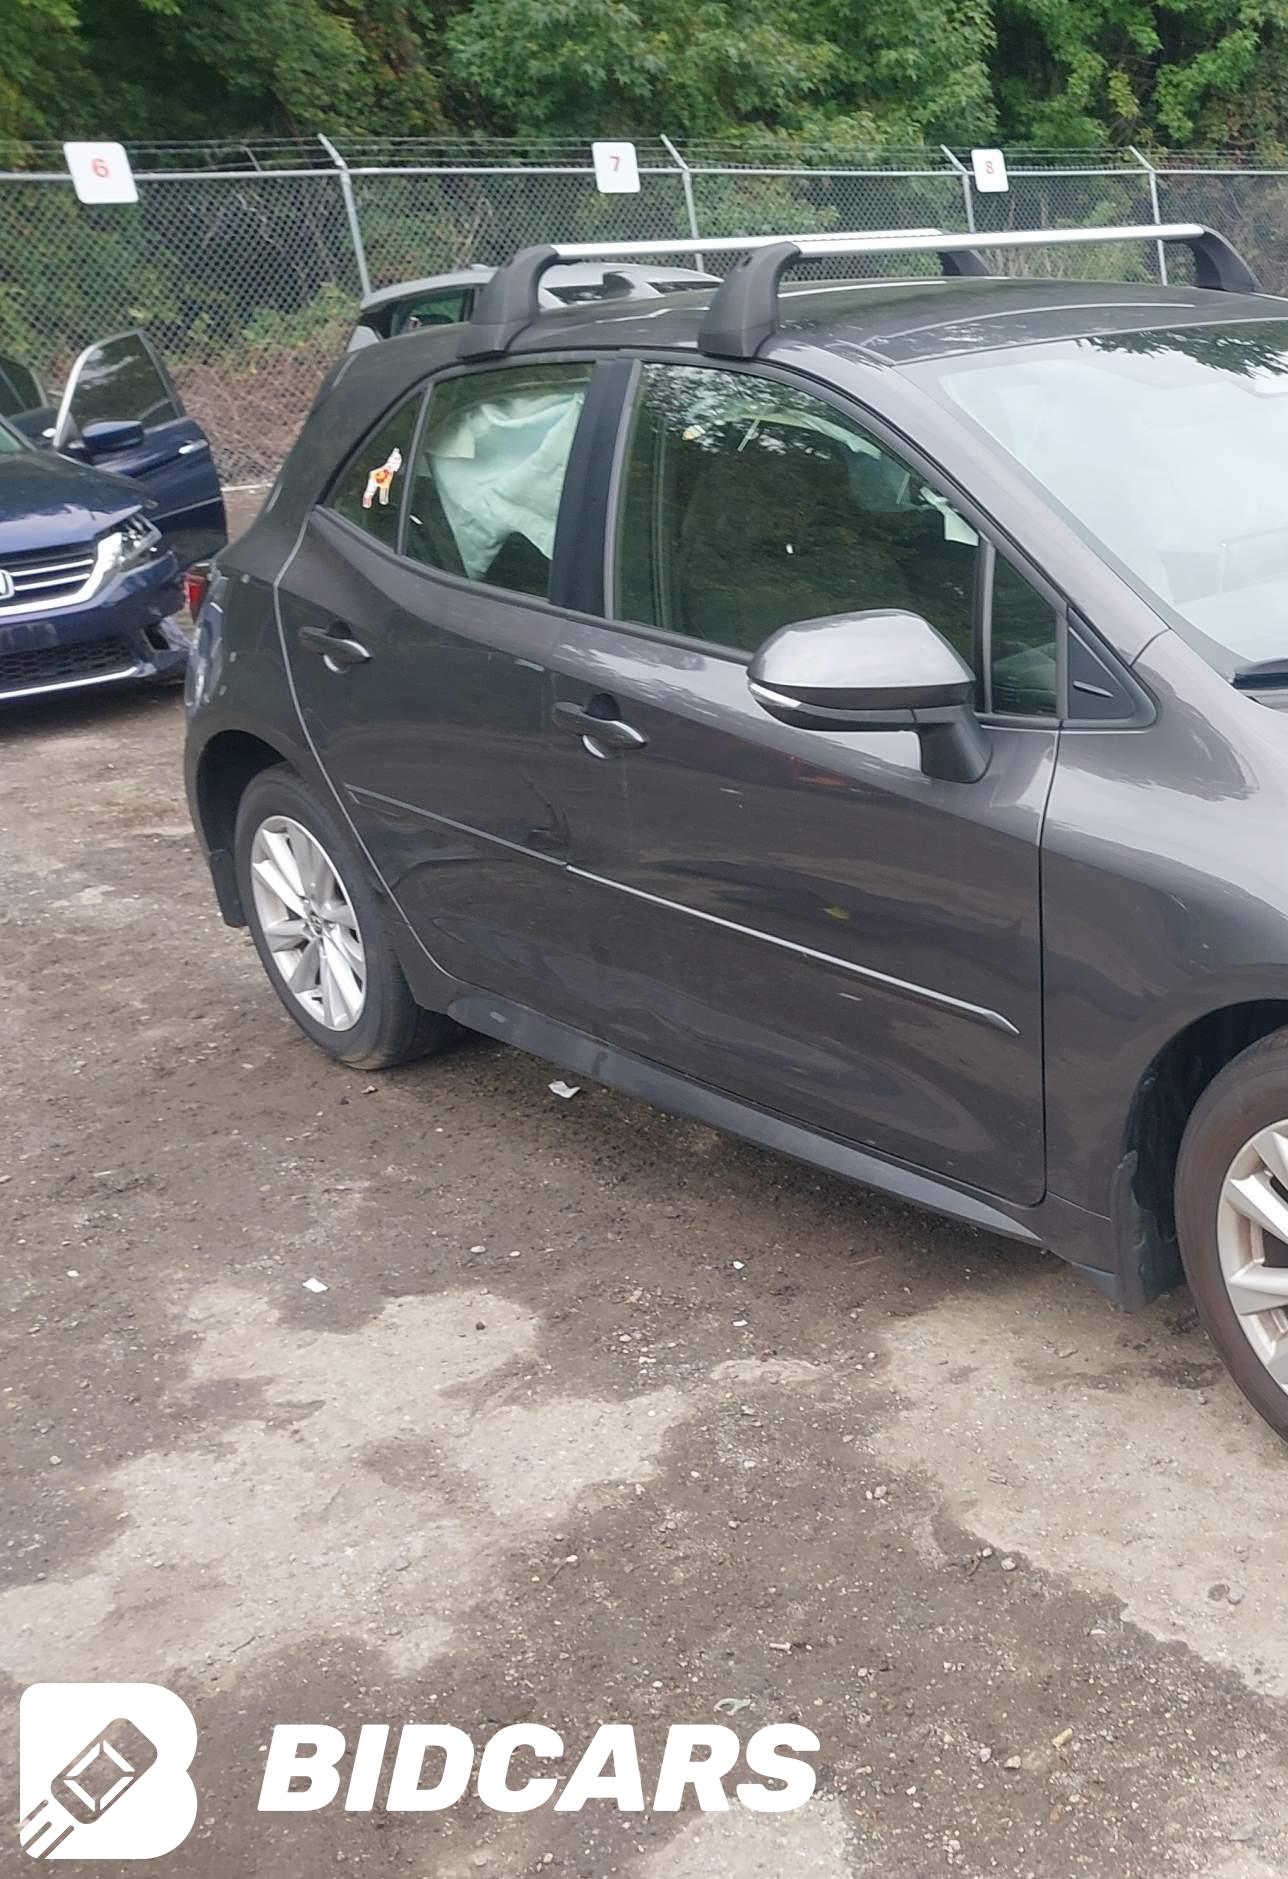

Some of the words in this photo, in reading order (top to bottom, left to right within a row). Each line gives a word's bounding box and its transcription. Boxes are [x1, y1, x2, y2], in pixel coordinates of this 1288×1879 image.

[91, 157, 110, 178] 6
[609, 155, 620, 172] 7
[984, 160, 995, 175] 8
